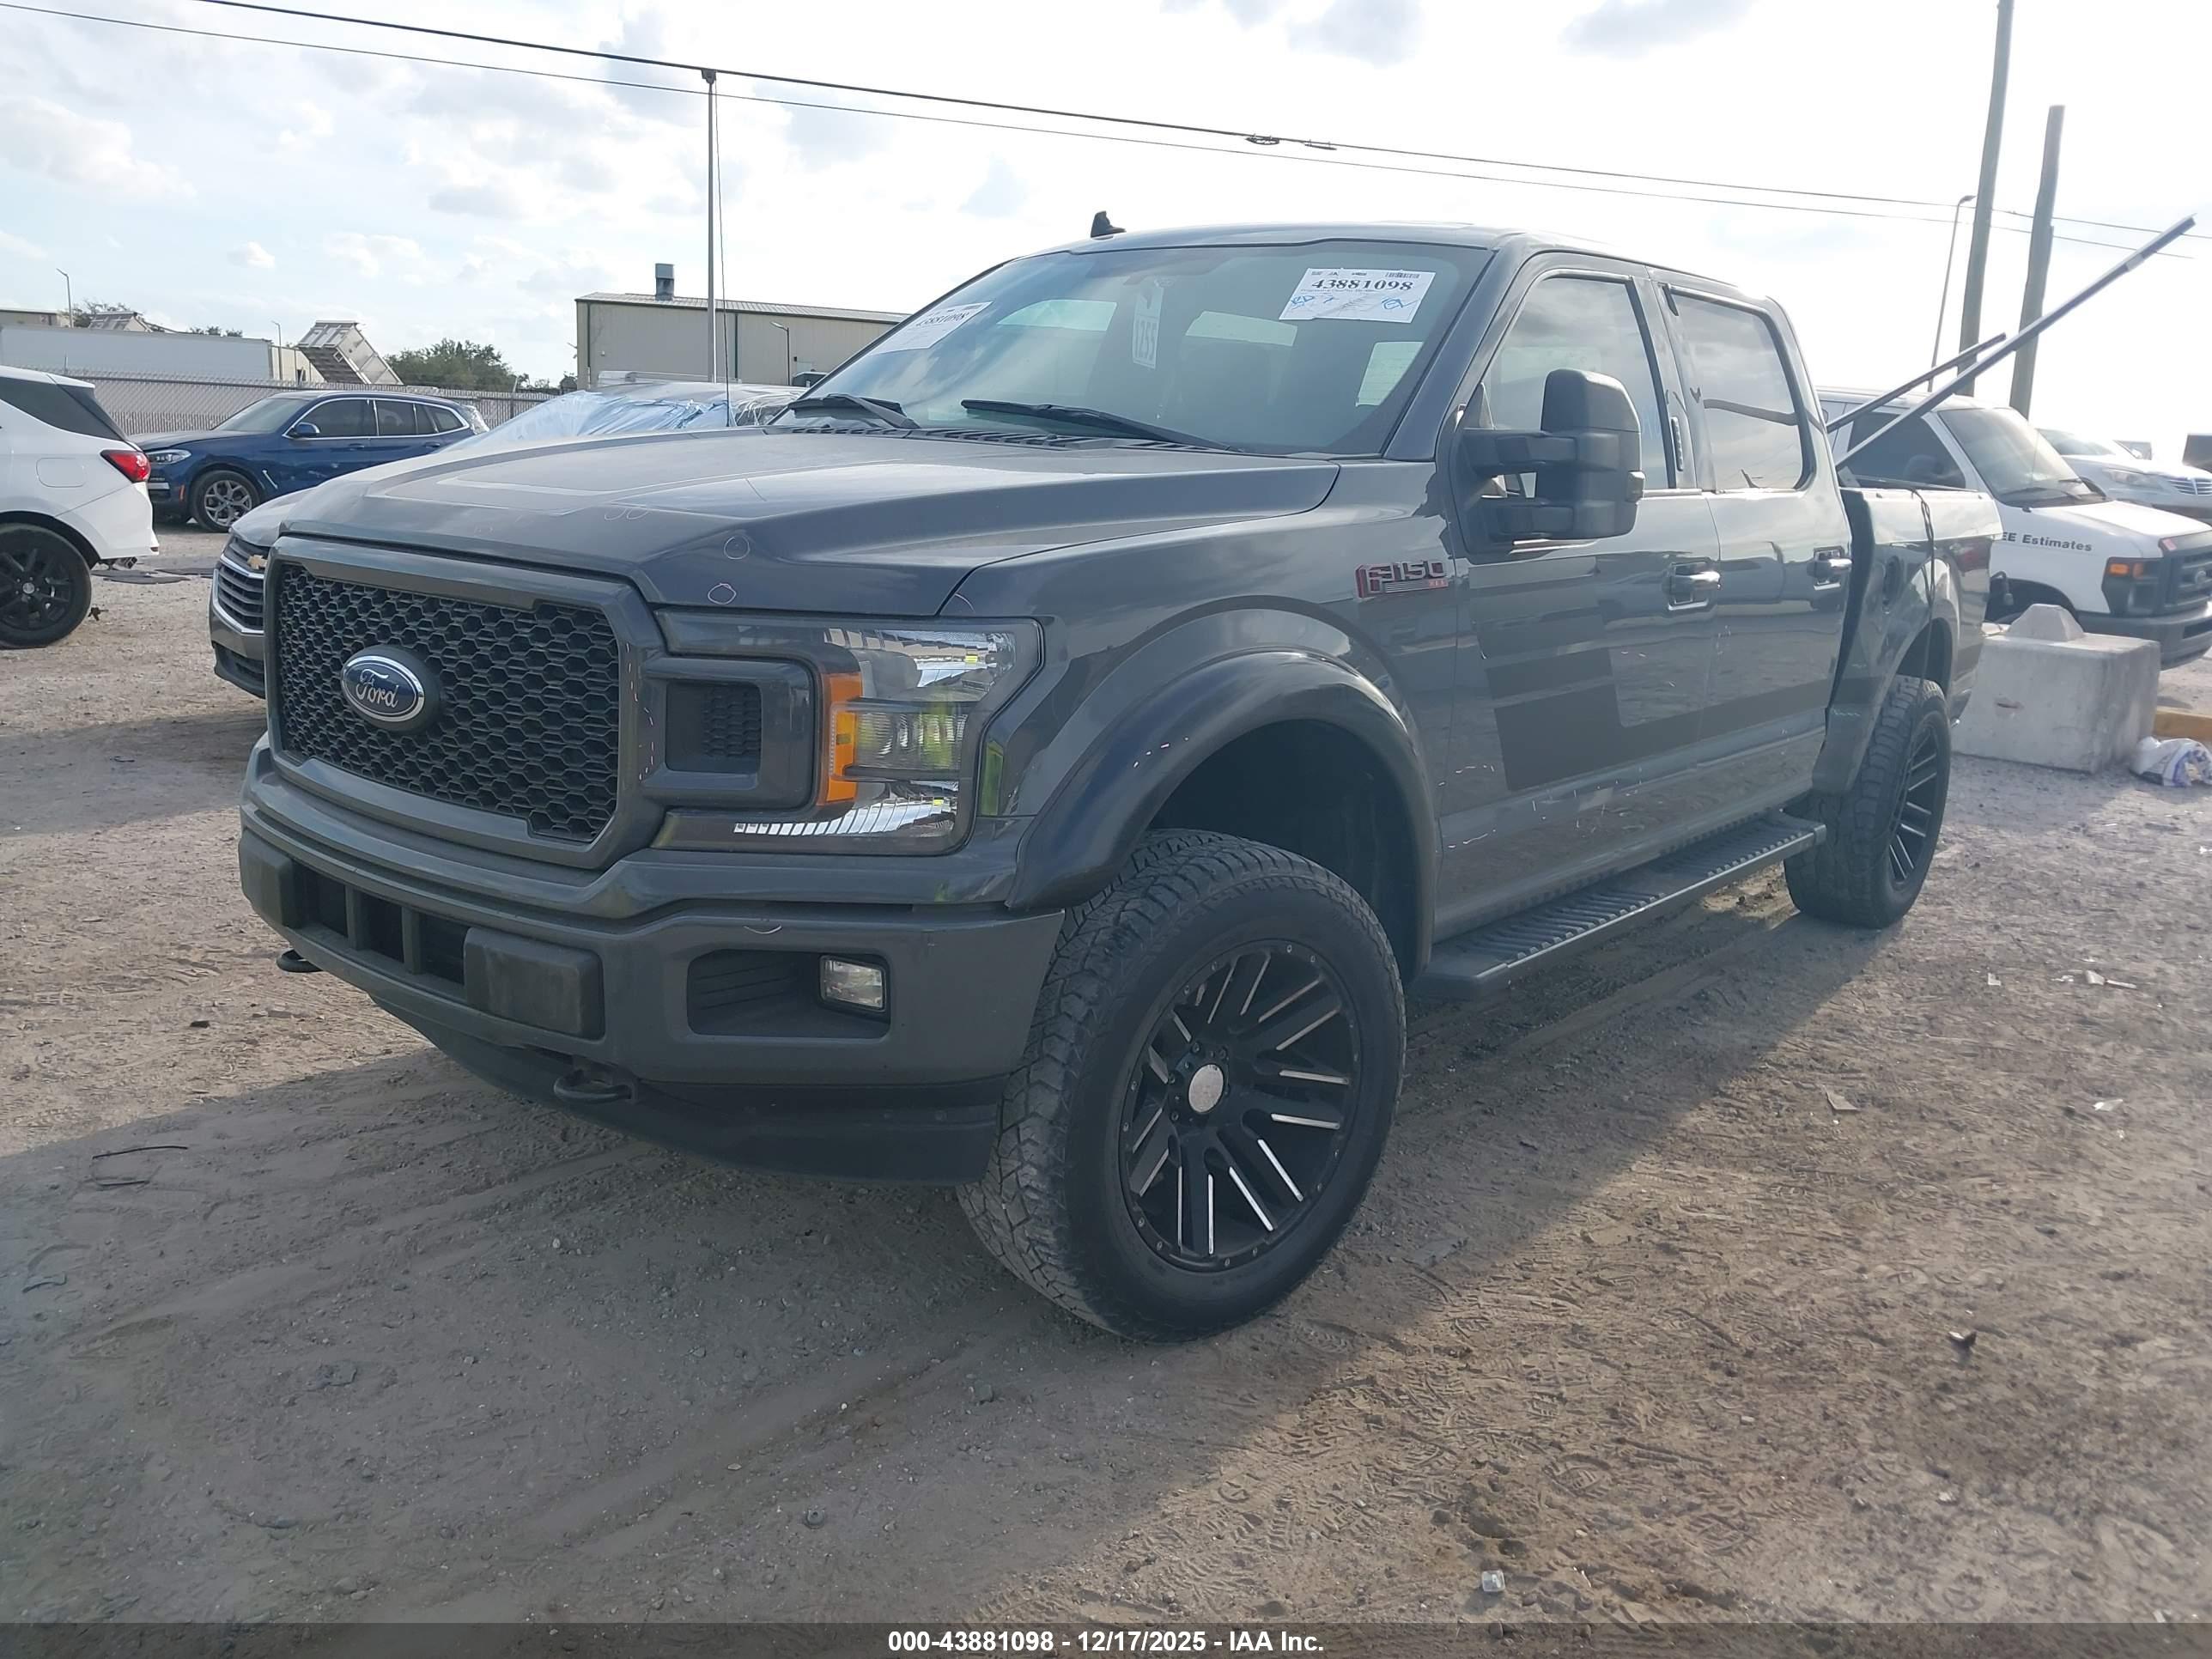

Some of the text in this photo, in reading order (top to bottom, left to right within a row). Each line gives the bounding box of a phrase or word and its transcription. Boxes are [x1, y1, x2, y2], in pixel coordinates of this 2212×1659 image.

[1311, 279, 1413, 292] 43881098
[2022, 534, 2093, 551] Estimates
[356, 668, 399, 708] Ford
